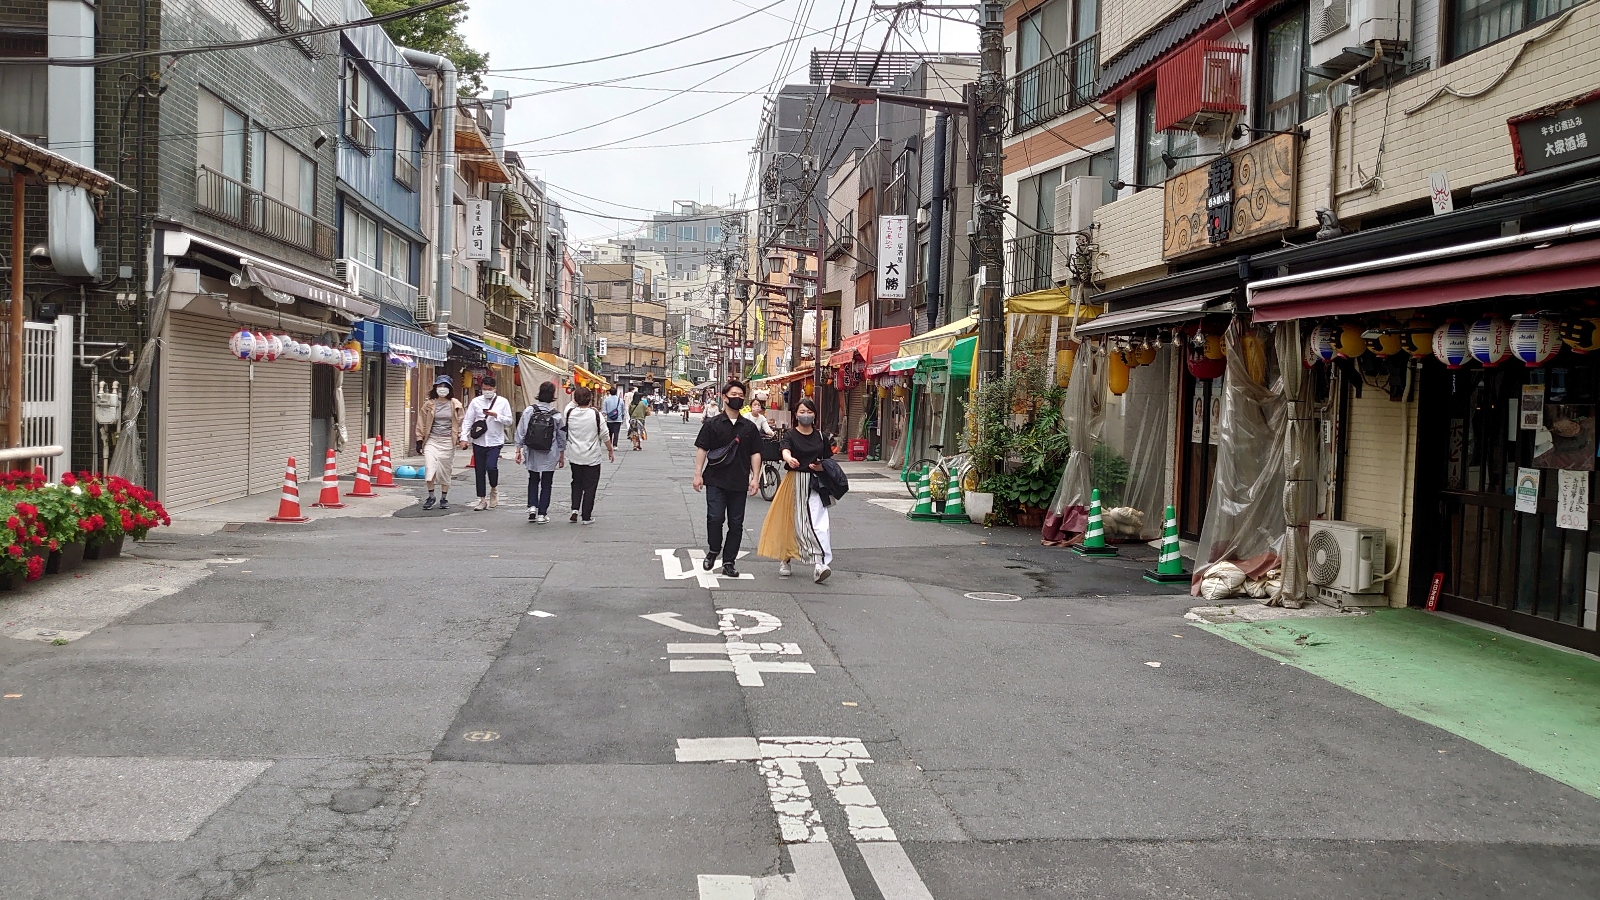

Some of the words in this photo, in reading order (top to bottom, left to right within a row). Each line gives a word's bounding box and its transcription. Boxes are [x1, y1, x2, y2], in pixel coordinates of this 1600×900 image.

[1544, 132, 1588, 158] 大衆酒場
[472, 224, 485, 251] 浩司
[885, 261, 900, 291] 大勝
[1493, 325, 1503, 354] アサヒビール
[1539, 323, 1551, 354] アサヒビール
[1449, 423, 1464, 476] ホッピー
